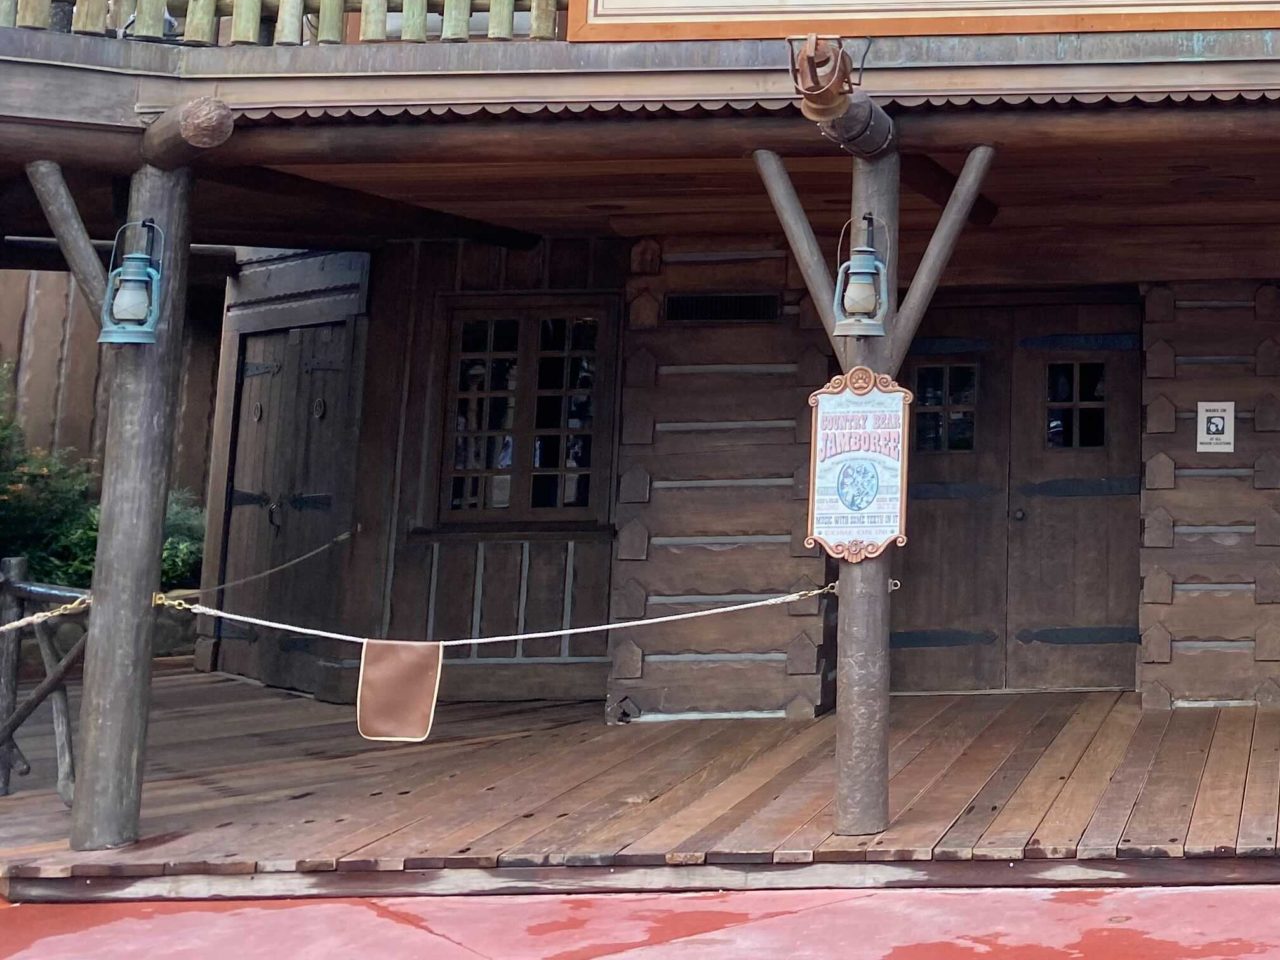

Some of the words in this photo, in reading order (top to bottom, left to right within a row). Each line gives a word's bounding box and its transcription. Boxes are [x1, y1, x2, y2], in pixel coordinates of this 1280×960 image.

[821, 415, 868, 430] COUNTRY
[873, 413, 901, 429] BEAR
[820, 431, 900, 462] JAMBOREE
[834, 515, 849, 525] WITH
[850, 515, 866, 524] SOME
[867, 515, 884, 524] TEETH
